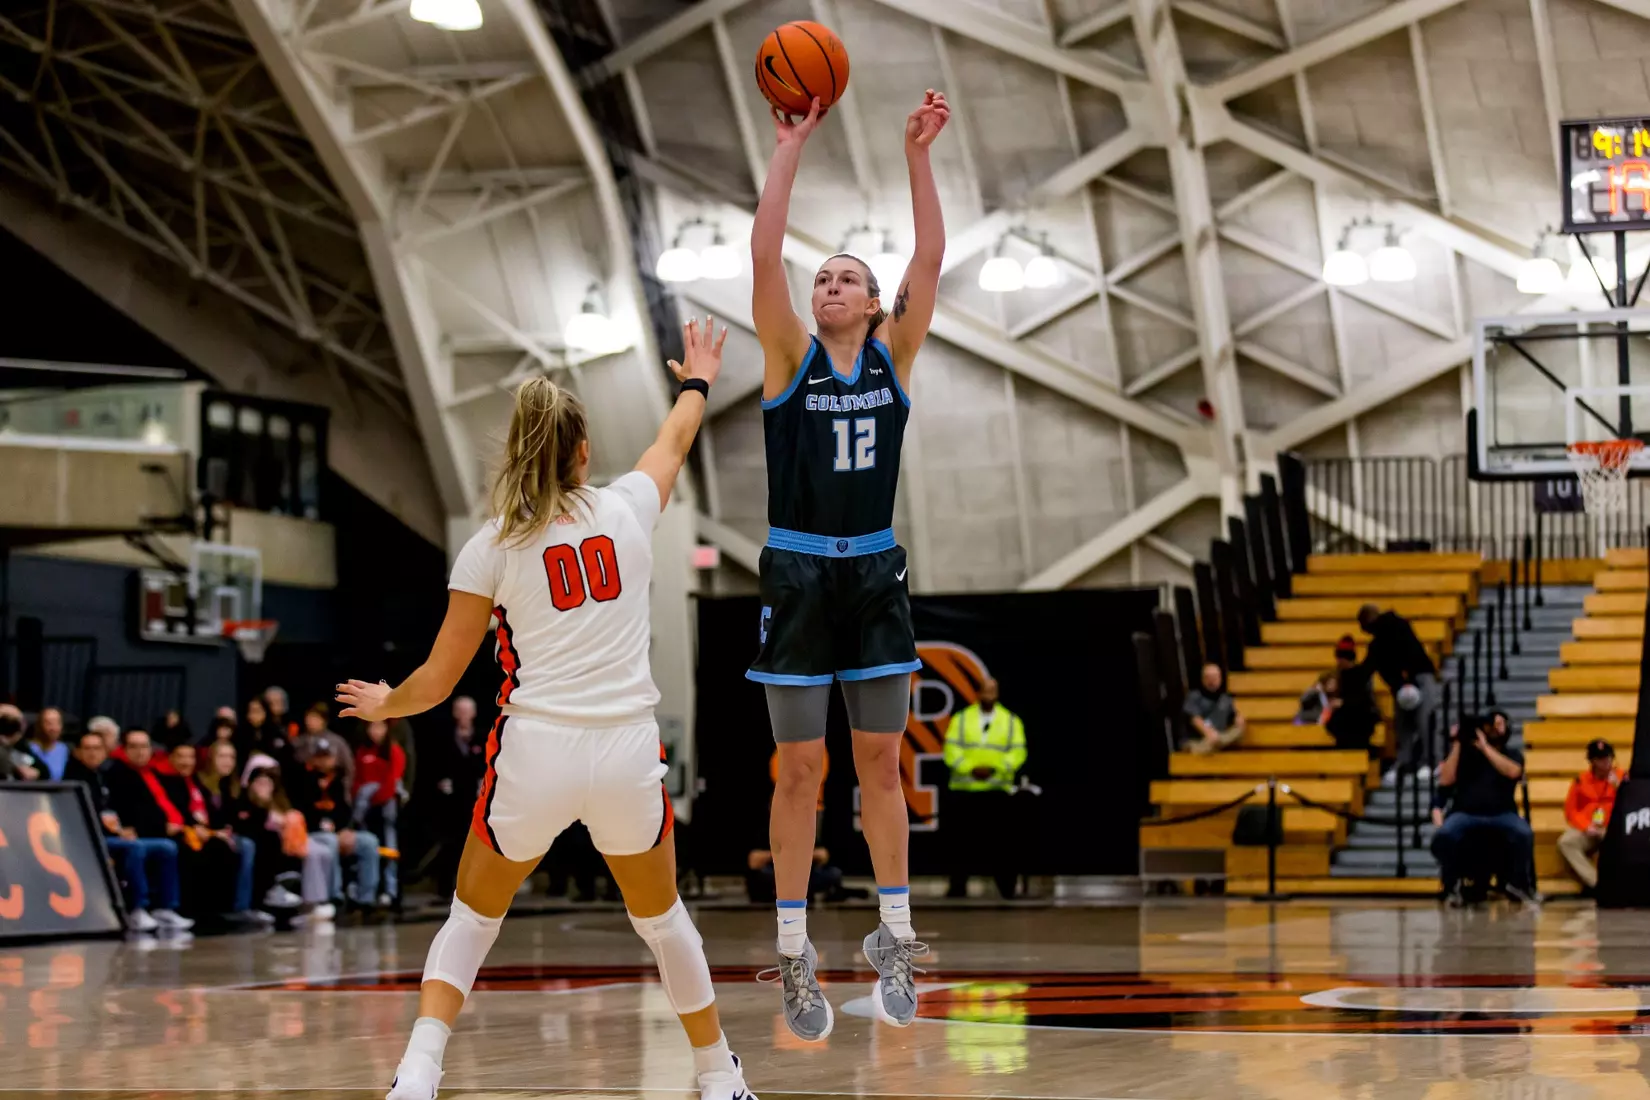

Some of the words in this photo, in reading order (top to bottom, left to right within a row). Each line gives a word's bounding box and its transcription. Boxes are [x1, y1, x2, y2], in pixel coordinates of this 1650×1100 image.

[805, 387, 894, 412] COLUMBIA
[832, 416, 876, 472] 12
[542, 534, 622, 612] 00
